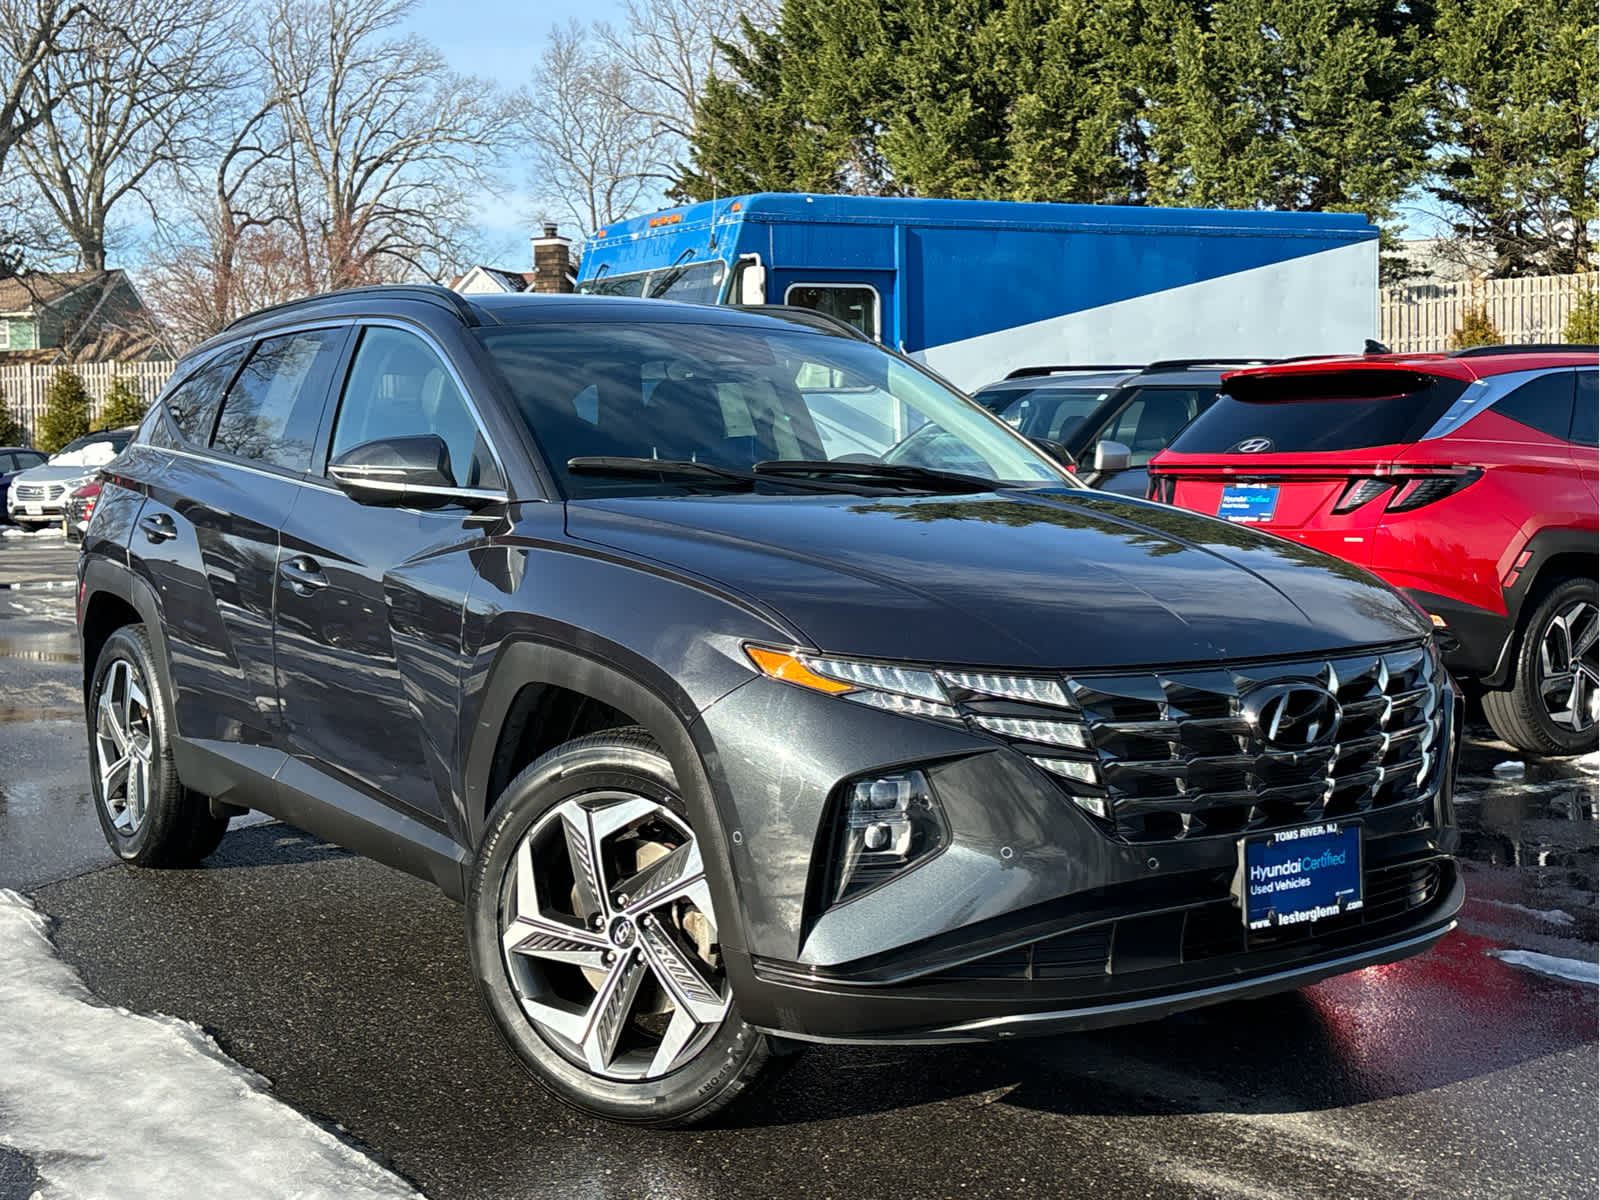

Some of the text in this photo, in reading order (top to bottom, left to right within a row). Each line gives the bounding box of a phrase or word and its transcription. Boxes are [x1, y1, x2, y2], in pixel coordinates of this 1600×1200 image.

[1273, 829, 1299, 843] TOMS
[1326, 823, 1338, 833] NJ
[1250, 877, 1311, 895] Used Vehicles
